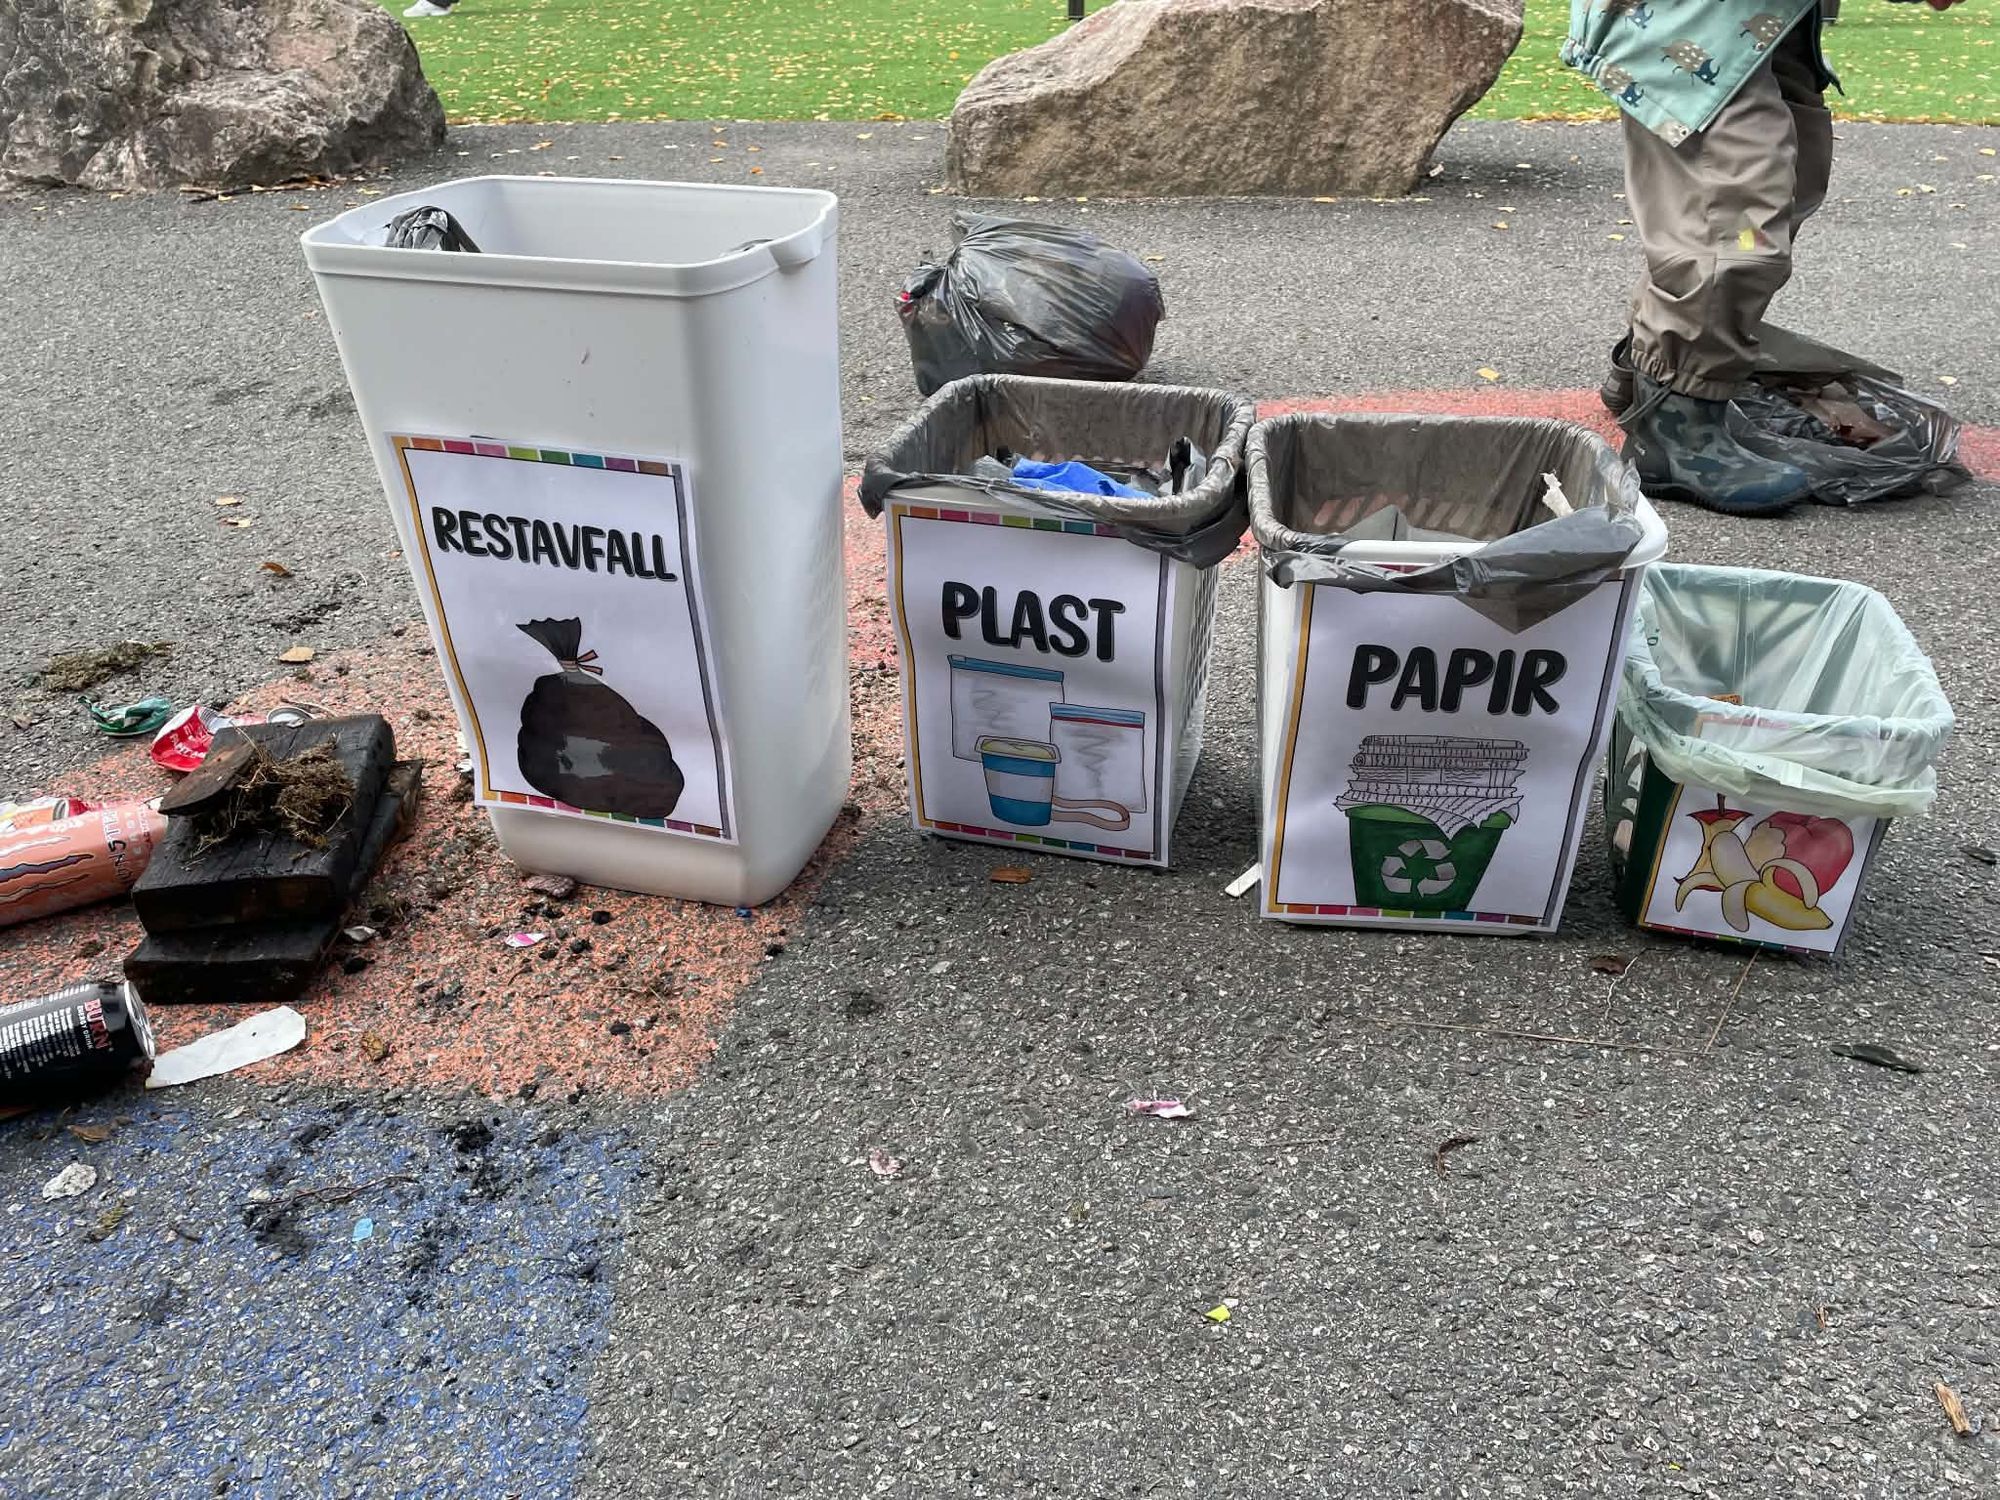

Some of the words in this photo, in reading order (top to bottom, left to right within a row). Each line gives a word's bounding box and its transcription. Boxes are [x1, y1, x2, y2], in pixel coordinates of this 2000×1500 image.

[432, 507, 678, 581] RESTAVFALL
[942, 581, 1126, 663] PLAST
[1346, 644, 1568, 716] PAPIR
[84, 998, 110, 1049] BURN
